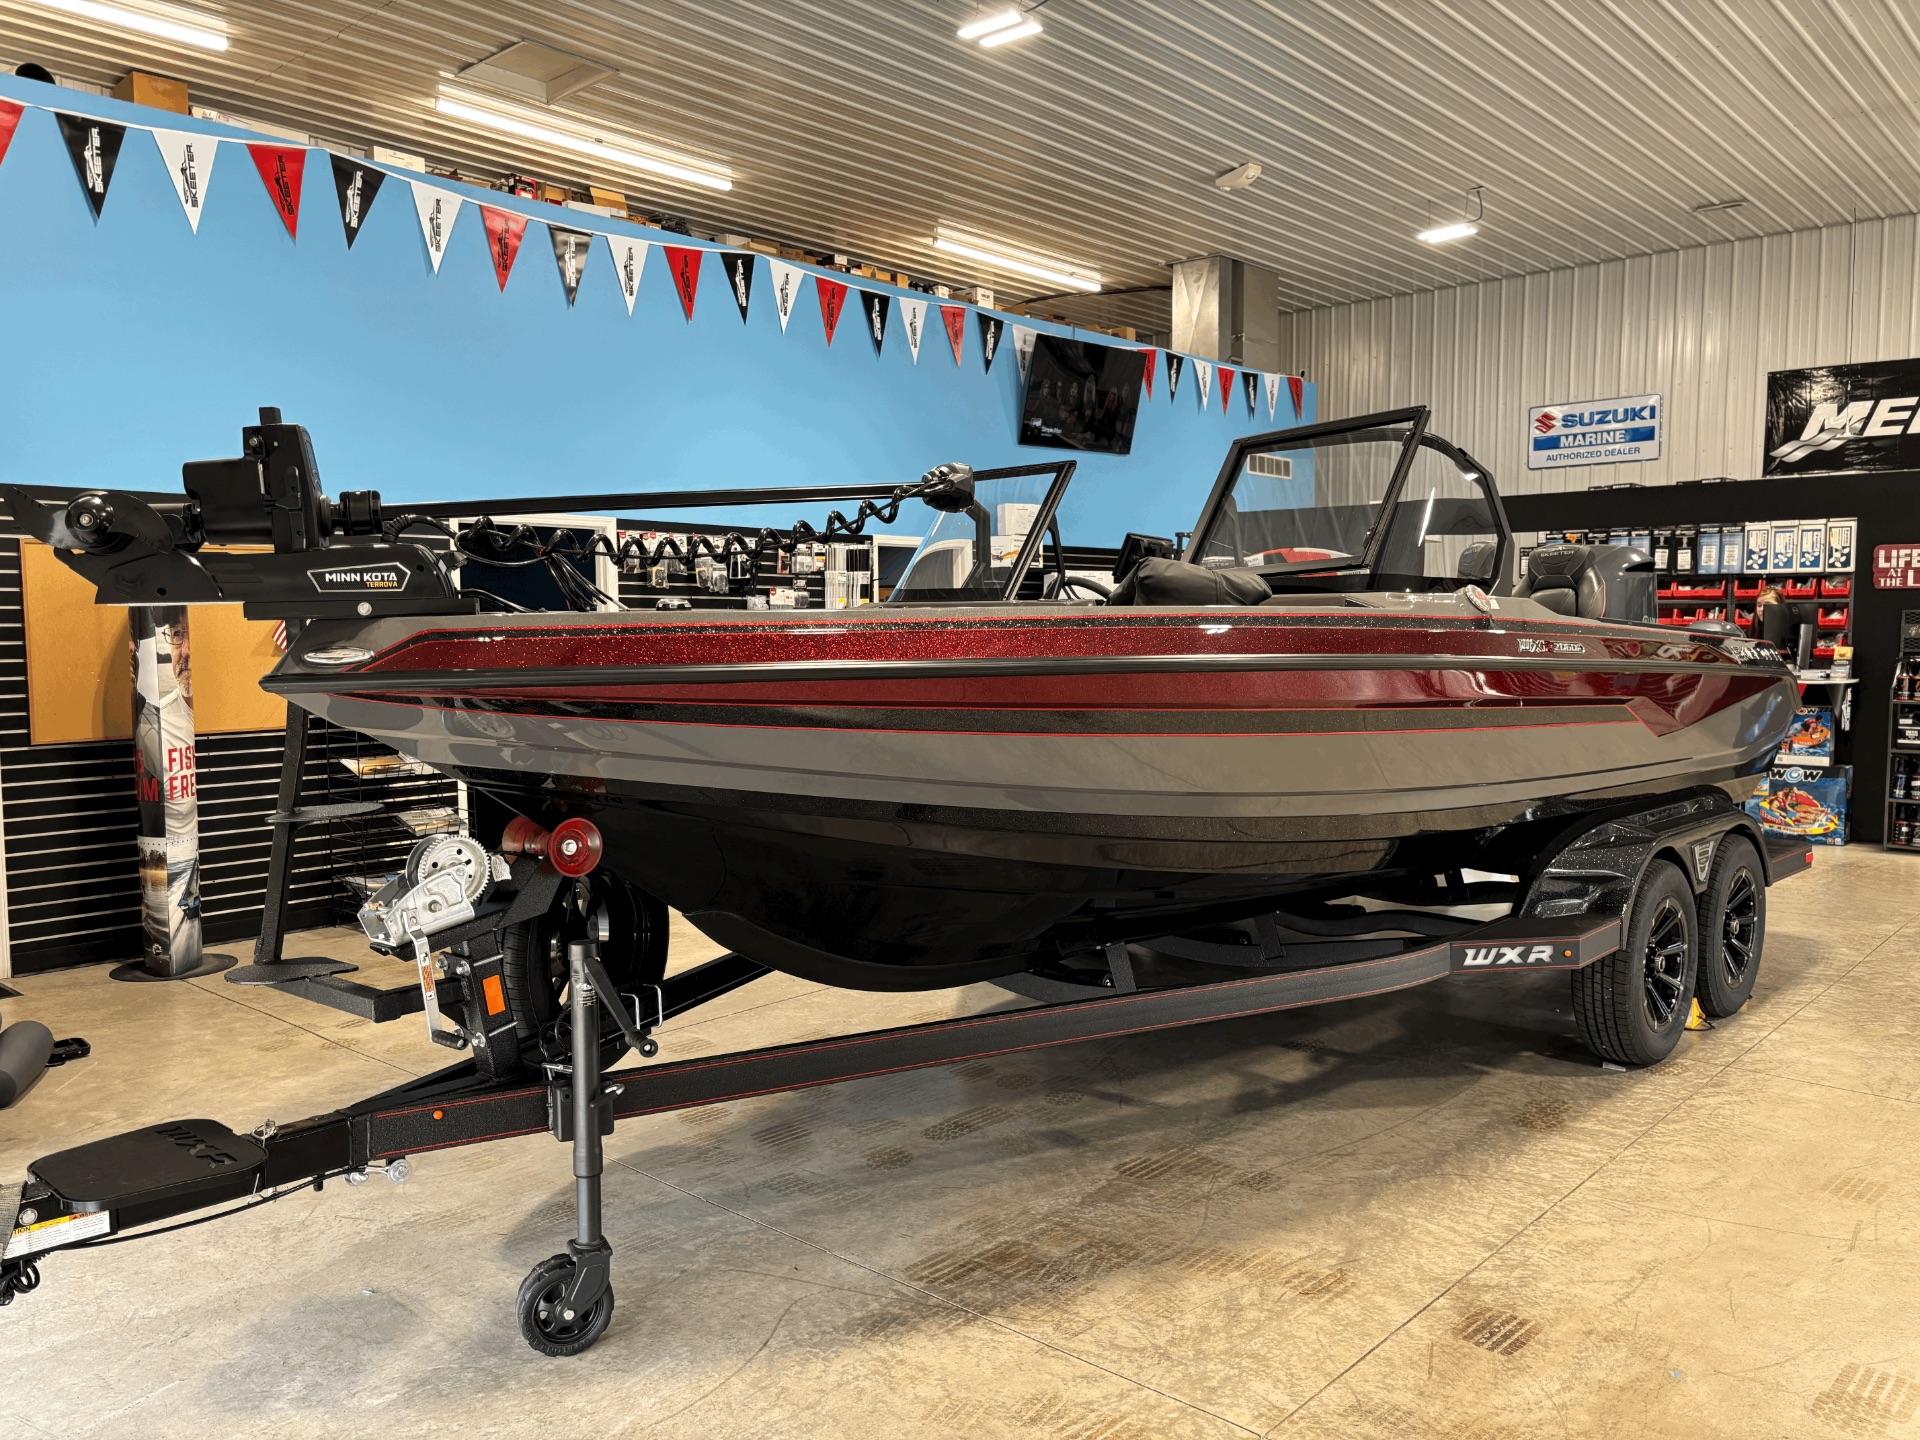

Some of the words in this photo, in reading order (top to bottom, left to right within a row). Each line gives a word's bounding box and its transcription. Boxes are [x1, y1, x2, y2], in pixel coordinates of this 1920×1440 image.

[91, 127, 104, 193] SKEETER
[186, 143, 199, 208] SKEETER
[278, 155, 295, 215] SKEETER
[350, 170, 364, 229] SKEETER
[1561, 405, 1656, 428] SUZUKI
[1800, 396, 1920, 440] ME
[1560, 429, 1626, 448] MARINE
[1546, 450, 1602, 462] AUTHORIZED
[1604, 446, 1641, 457] DEALER
[1540, 550, 1575, 558] SKEETER
[1878, 549, 1920, 568] LIFE
[325, 573, 361, 582] MINN
[363, 572, 398, 581] KOTA
[1888, 568, 1904, 577] AT
[1878, 578, 1903, 587] THE
[1795, 707, 1818, 716] OW
[1769, 766, 1823, 783] WOW
[1463, 945, 1554, 966] WXR
[12, 1225, 31, 1236] TION
